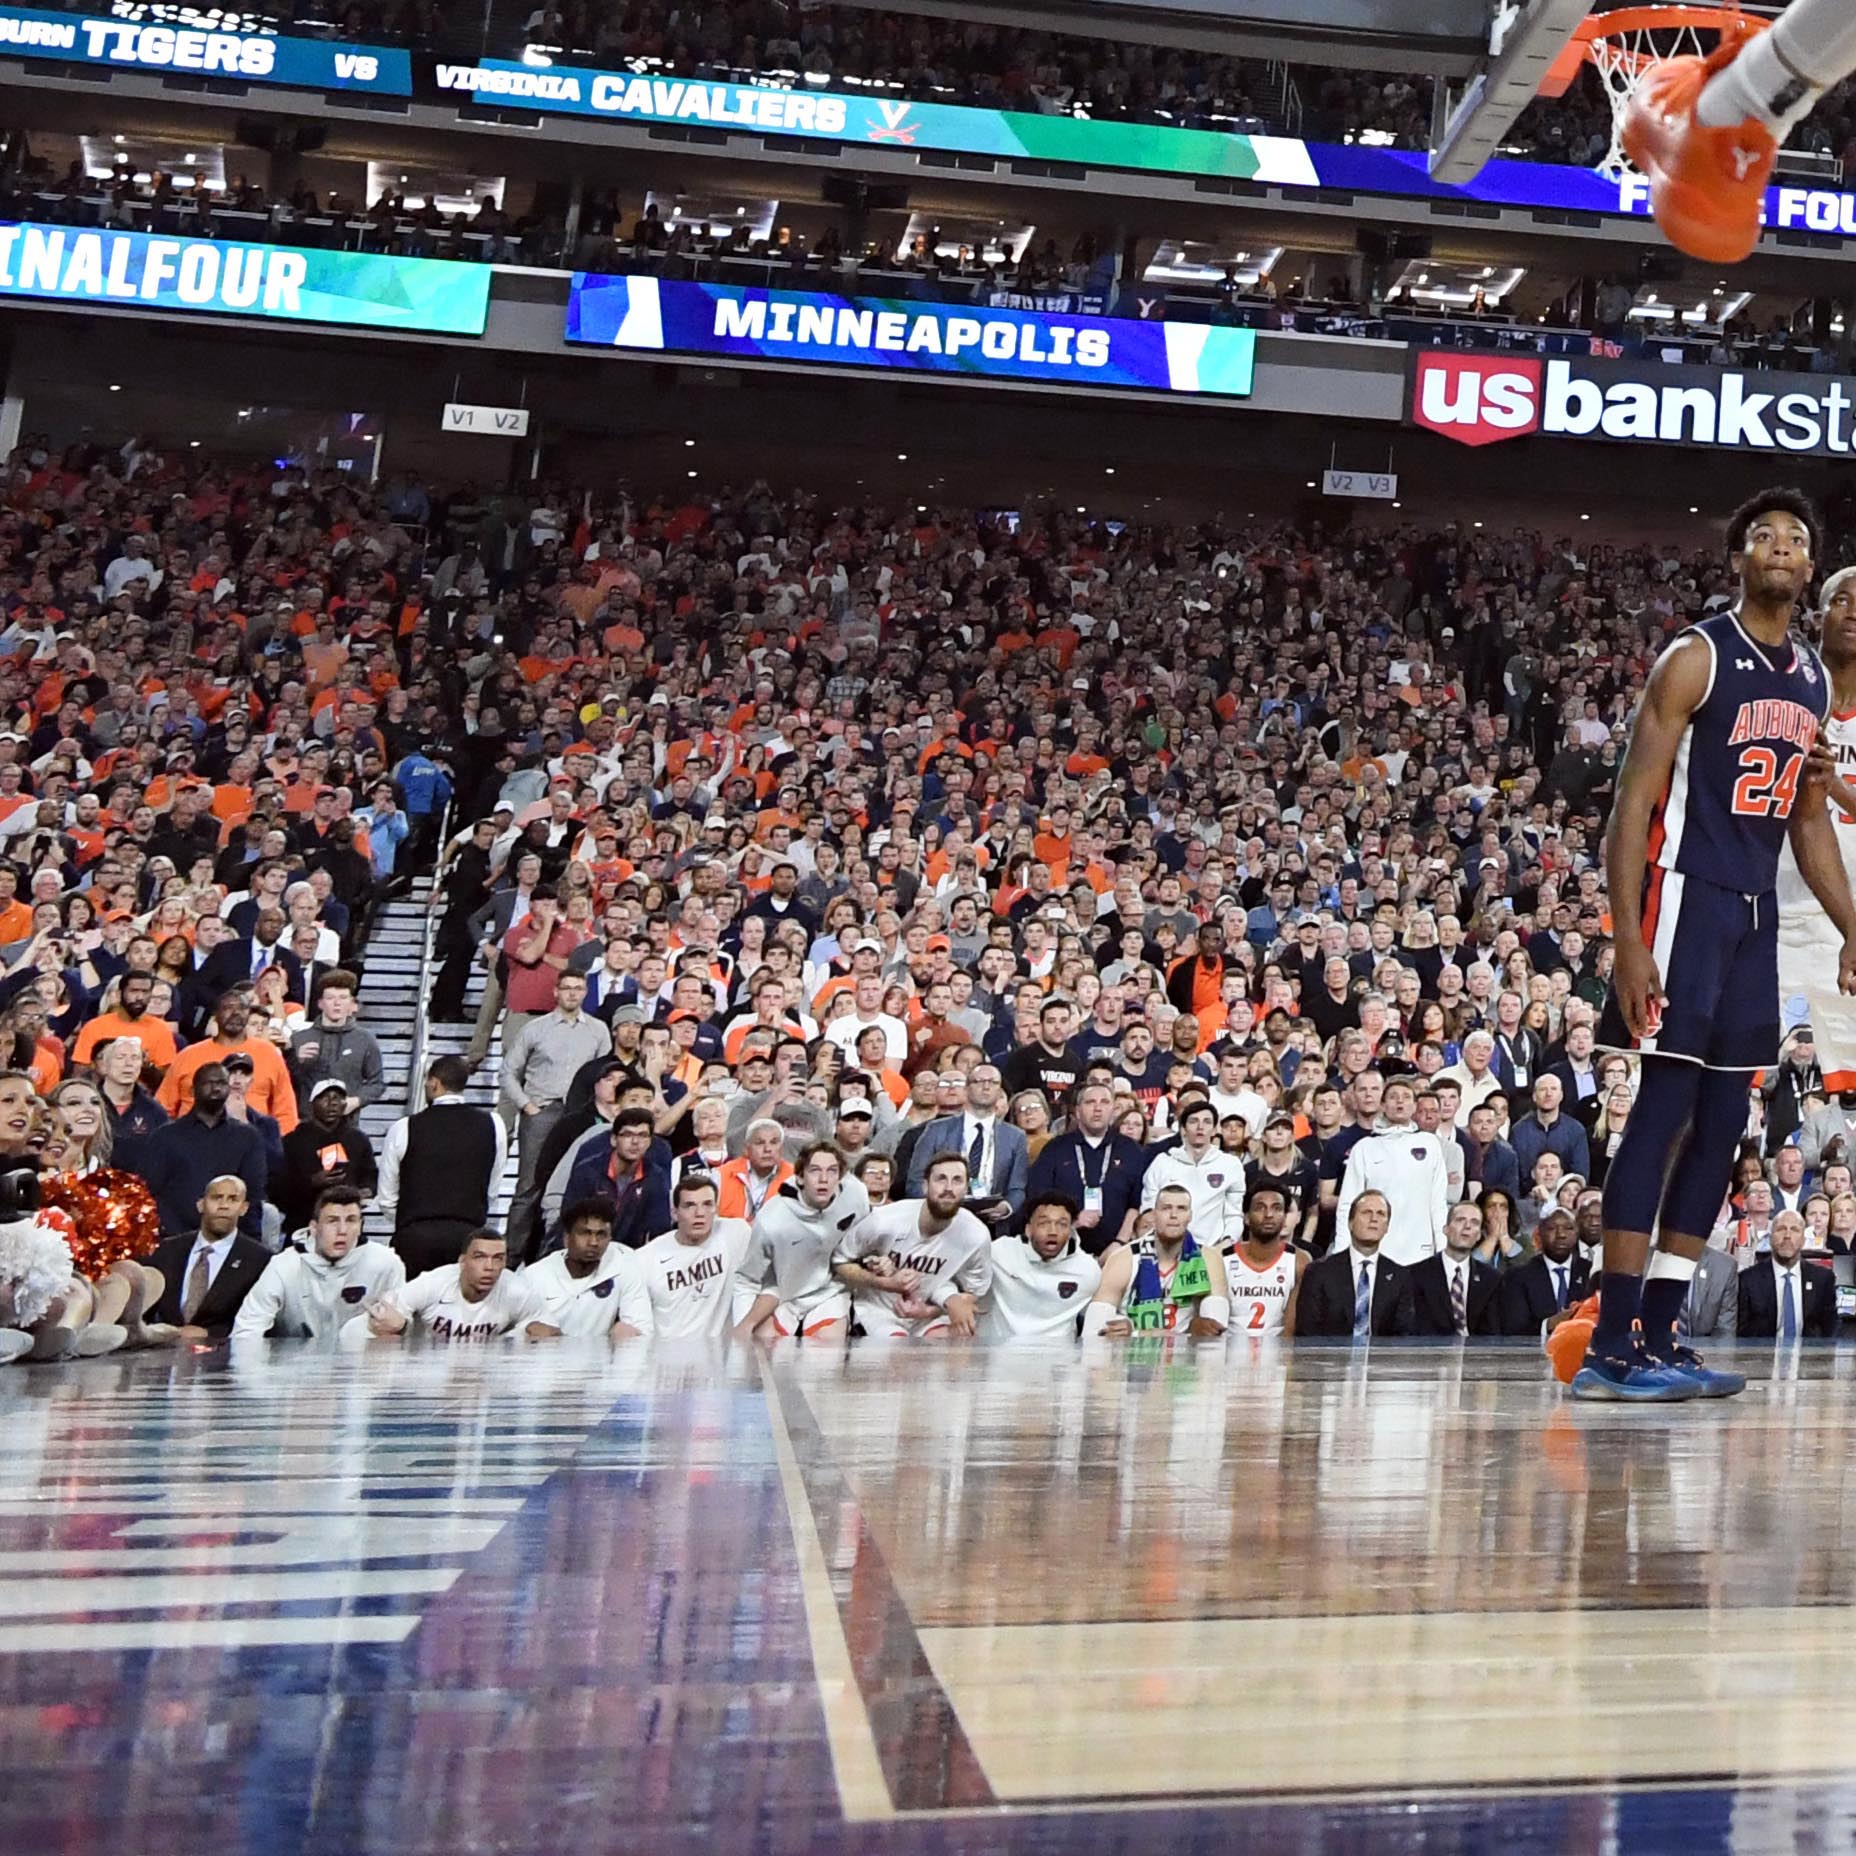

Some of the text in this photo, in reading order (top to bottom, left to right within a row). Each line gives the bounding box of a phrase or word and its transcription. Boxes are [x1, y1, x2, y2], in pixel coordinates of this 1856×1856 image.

[82, 19, 277, 75] TIGERS
[334, 52, 379, 81] VS
[435, 63, 581, 103] VIRGINIA
[590, 74, 847, 133] CAVALIERS
[712, 297, 1111, 368] MINNEAPOLIS
[451, 409, 520, 430] V1 V2
[1330, 475, 1391, 493] V2 V3
[1731, 745, 1807, 820] 24
[666, 1254, 724, 1291] FAMILY
[888, 1251, 948, 1276] FAMILY
[1231, 1286, 1285, 1297] VIRGINIA
[1246, 1301, 1266, 1330] 2
